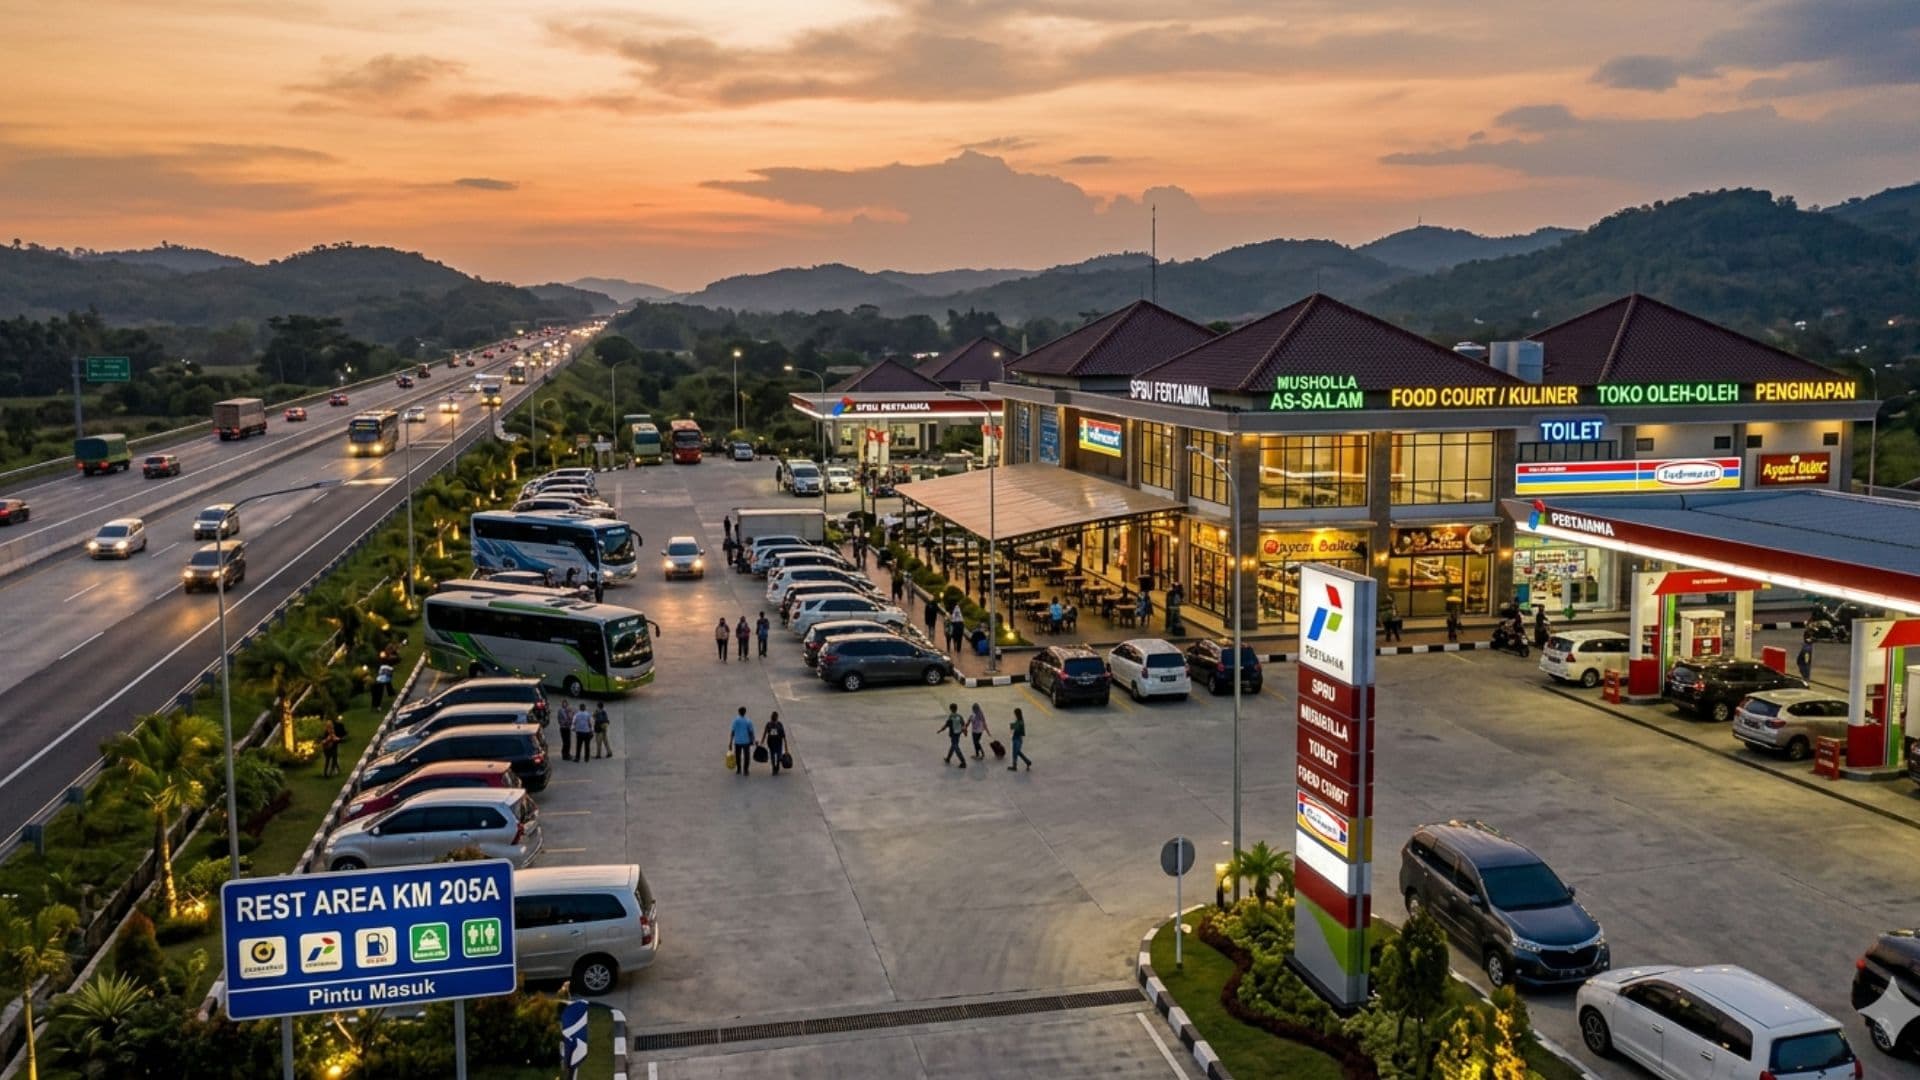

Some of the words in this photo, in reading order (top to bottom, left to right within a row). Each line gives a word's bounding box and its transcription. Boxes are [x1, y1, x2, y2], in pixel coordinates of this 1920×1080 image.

[1277, 375, 1357, 390] MUSHOLLA
[1755, 382, 1856, 401] PENGINAPAN
[1270, 391, 1364, 409] AS-SALAM
[1391, 388, 1437, 408] FOOD
[1440, 387, 1496, 406] COURT
[1499, 386, 1505, 406] /
[1508, 385, 1578, 405] KULINER
[1597, 384, 1643, 404] TOKO
[1650, 383, 1739, 403] OLEH-OLEH
[1541, 421, 1603, 440] TOILET
[236, 891, 306, 923] REST
[313, 886, 386, 916] AREA
[393, 881, 432, 909] KM
[439, 877, 500, 905] 205A
[309, 986, 362, 1006] Pintu
[369, 979, 436, 1000] Masuk
